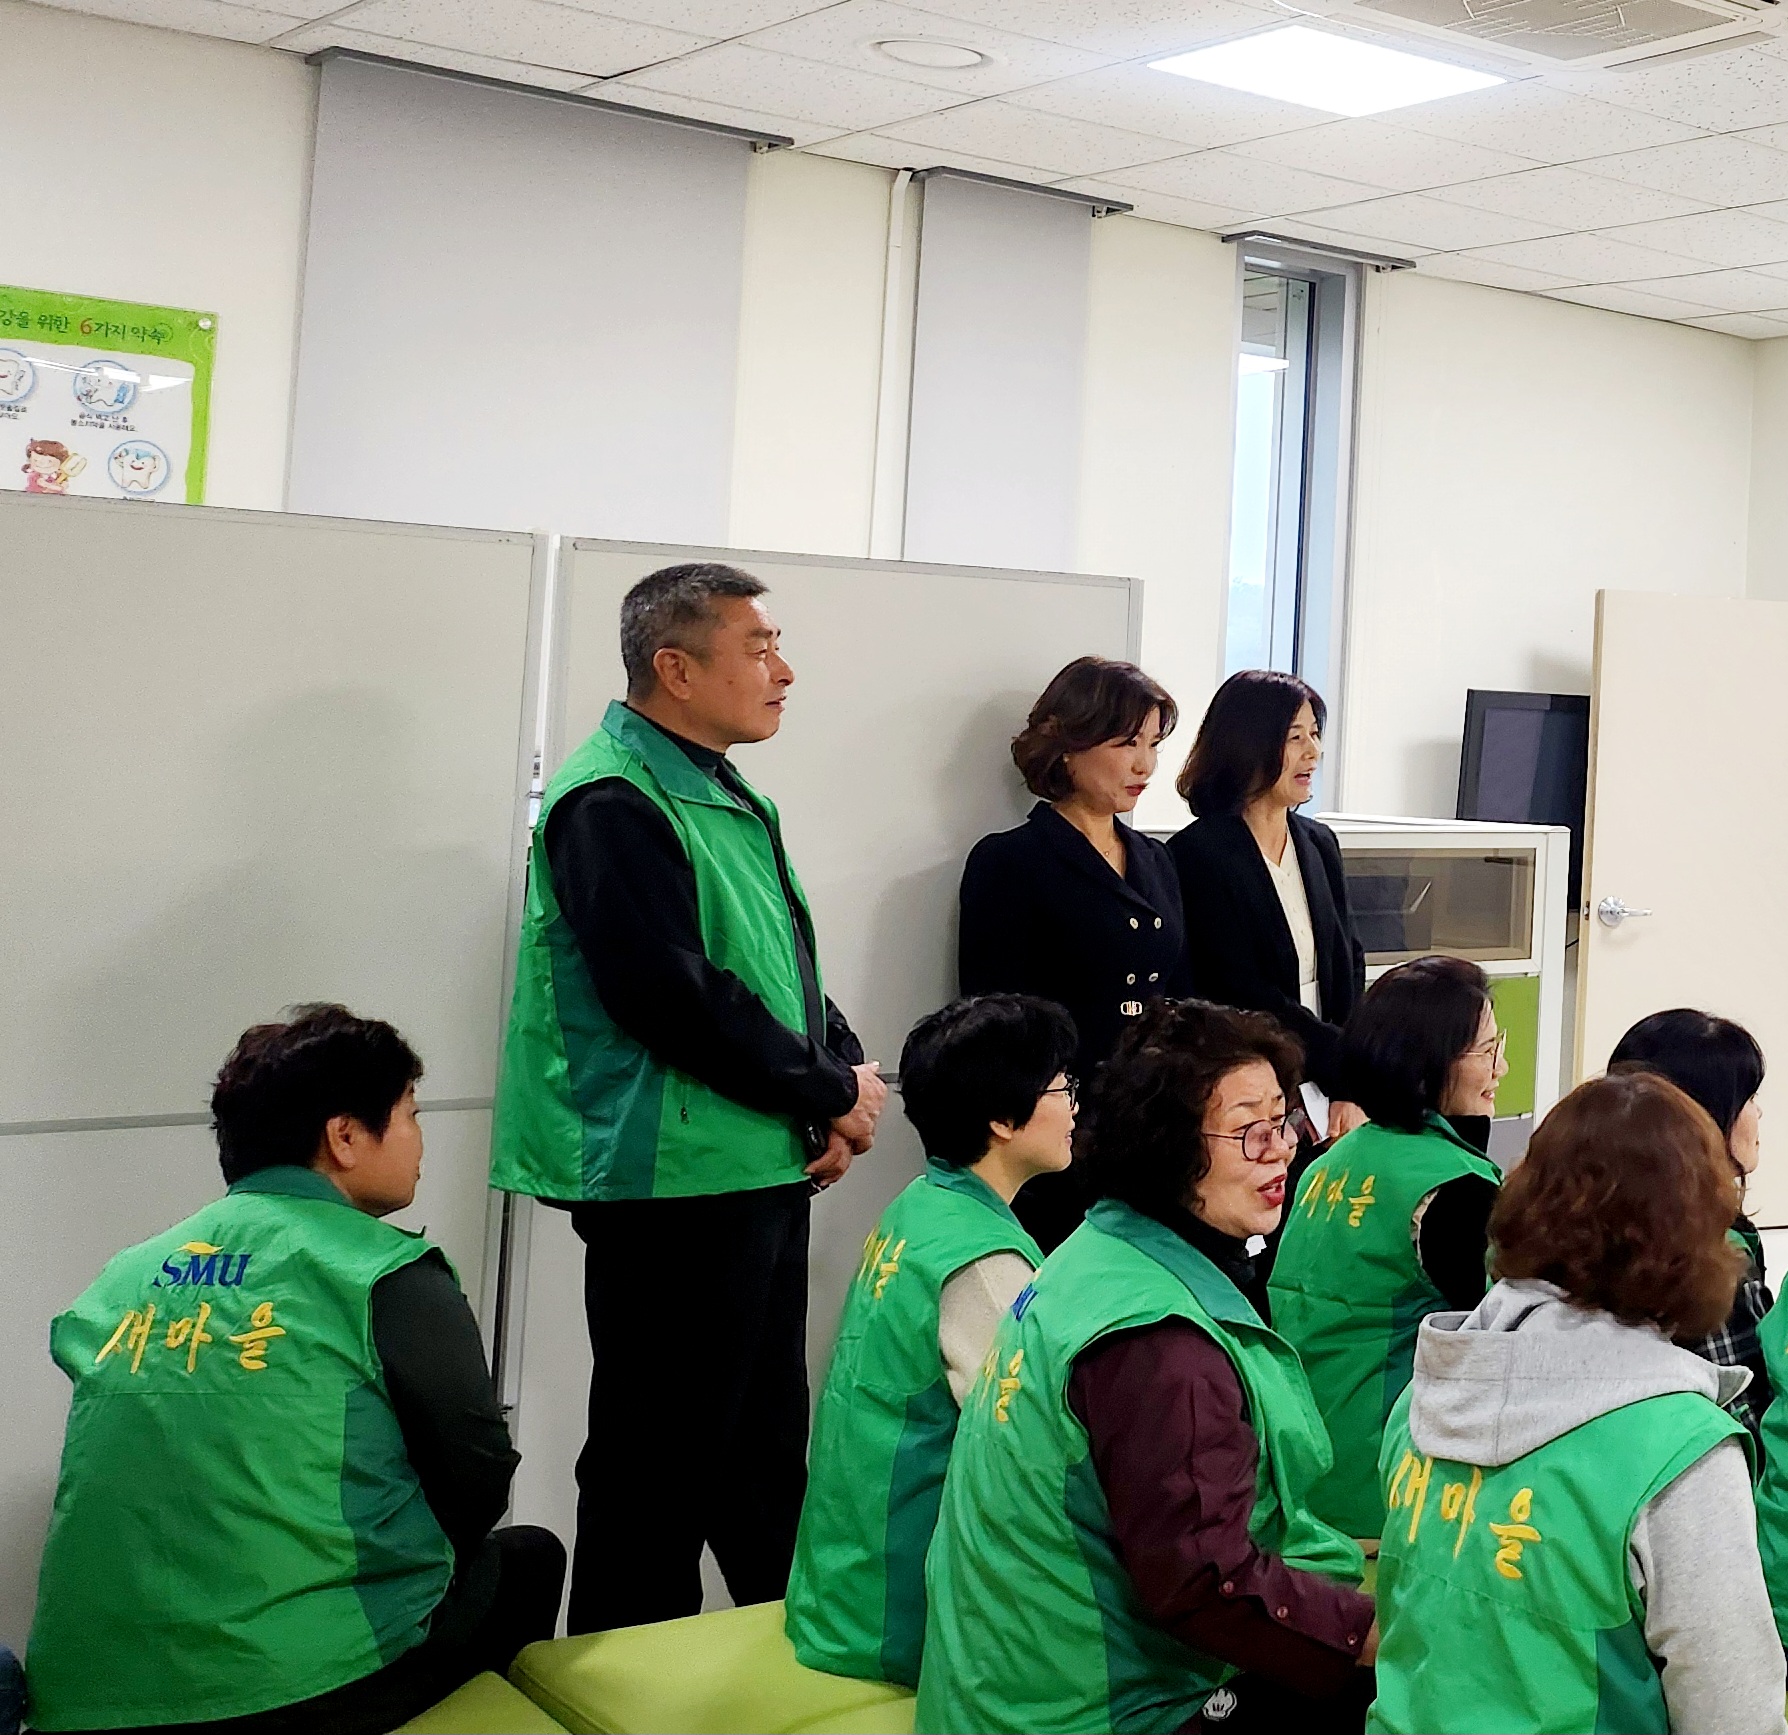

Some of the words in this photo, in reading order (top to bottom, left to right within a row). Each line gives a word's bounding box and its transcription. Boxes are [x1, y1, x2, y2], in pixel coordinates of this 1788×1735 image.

[37, 313, 70, 334] 위한
[80, 317, 126, 340] 6가지
[131, 325, 166, 345] 약속
[153, 1253, 252, 1288] SMU
[94, 1301, 287, 1375] 새마을
[980, 1347, 1025, 1423] 마을
[1389, 1448, 1542, 1580] 새마을
